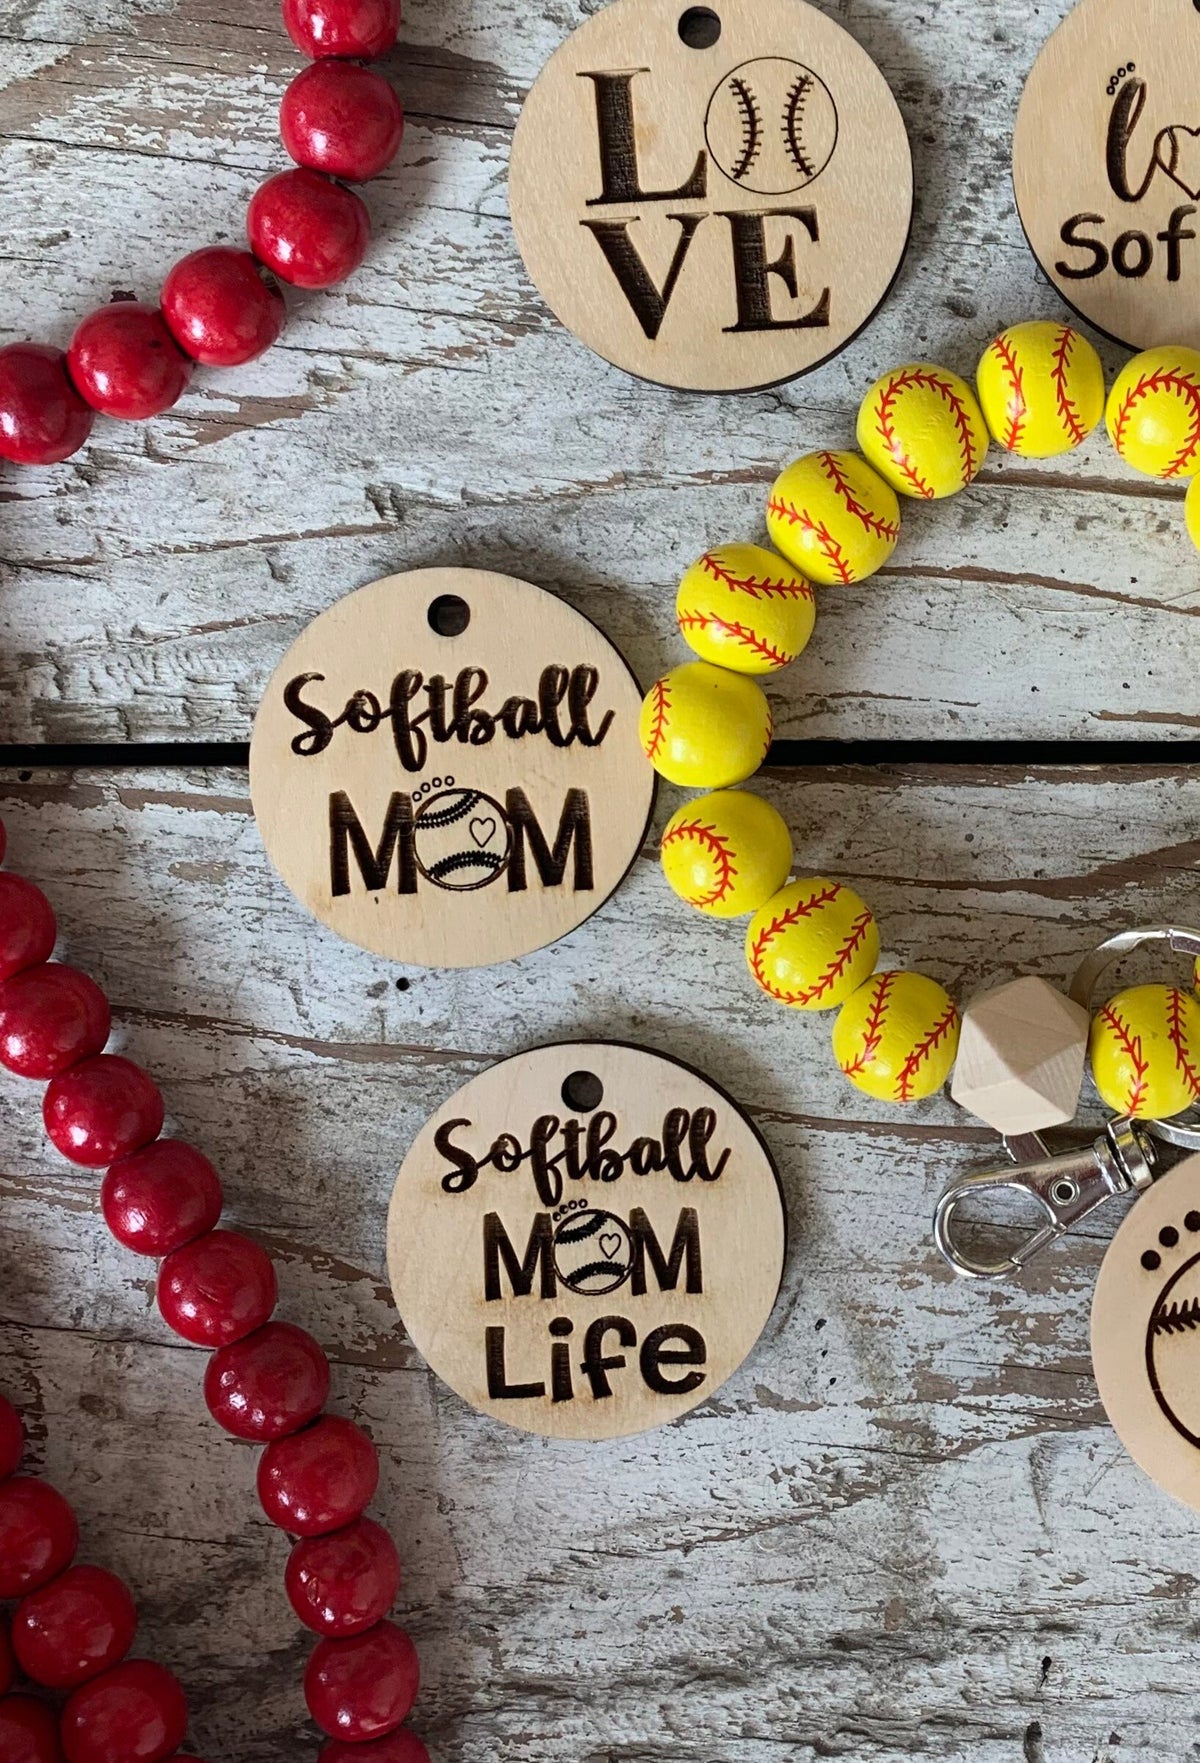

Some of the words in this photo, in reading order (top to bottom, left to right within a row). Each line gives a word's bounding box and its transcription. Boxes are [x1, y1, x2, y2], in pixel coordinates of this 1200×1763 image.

[579, 204, 831, 340] VE
[1055, 204, 1197, 282] Sof
[283, 663, 616, 773] Softball
[328, 786, 595, 897] MOM
[434, 1106, 732, 1208] Softball
[482, 1206, 704, 1302] MOM
[484, 1315, 708, 1404] Life
